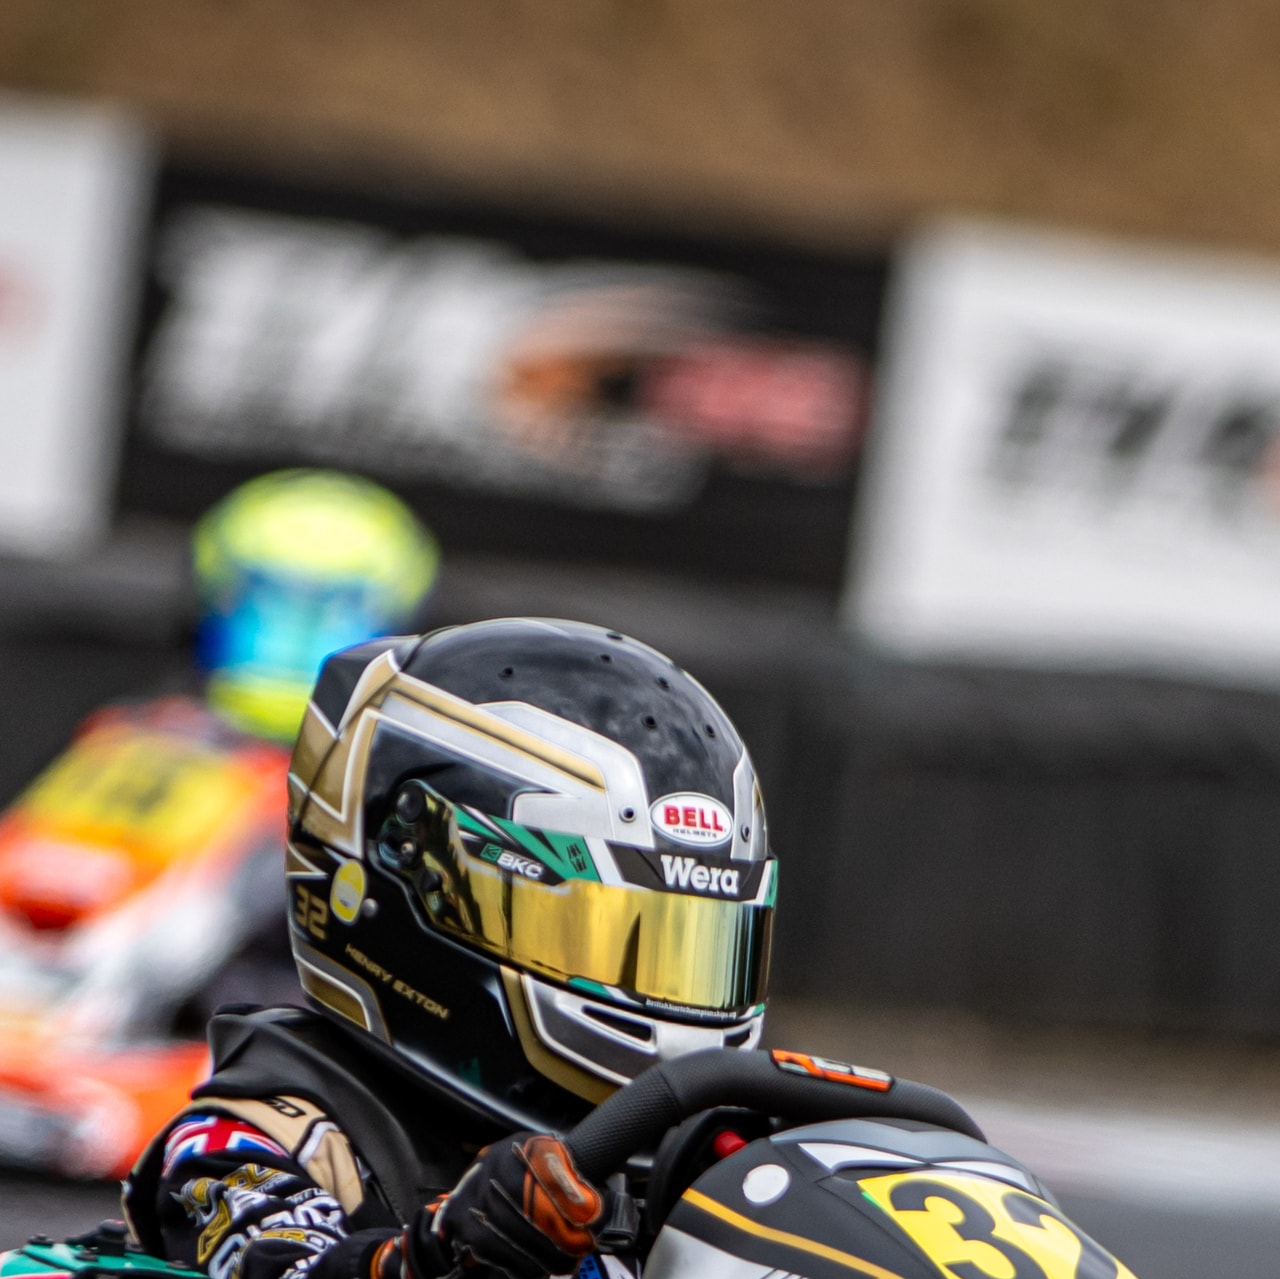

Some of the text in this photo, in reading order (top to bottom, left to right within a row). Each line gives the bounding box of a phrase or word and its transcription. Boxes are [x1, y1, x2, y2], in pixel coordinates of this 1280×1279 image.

[663, 804, 724, 832] BELL
[497, 853, 543, 880] BKC
[660, 854, 739, 896] Wera
[295, 884, 329, 940] 32
[392, 979, 450, 1019] EXTON
